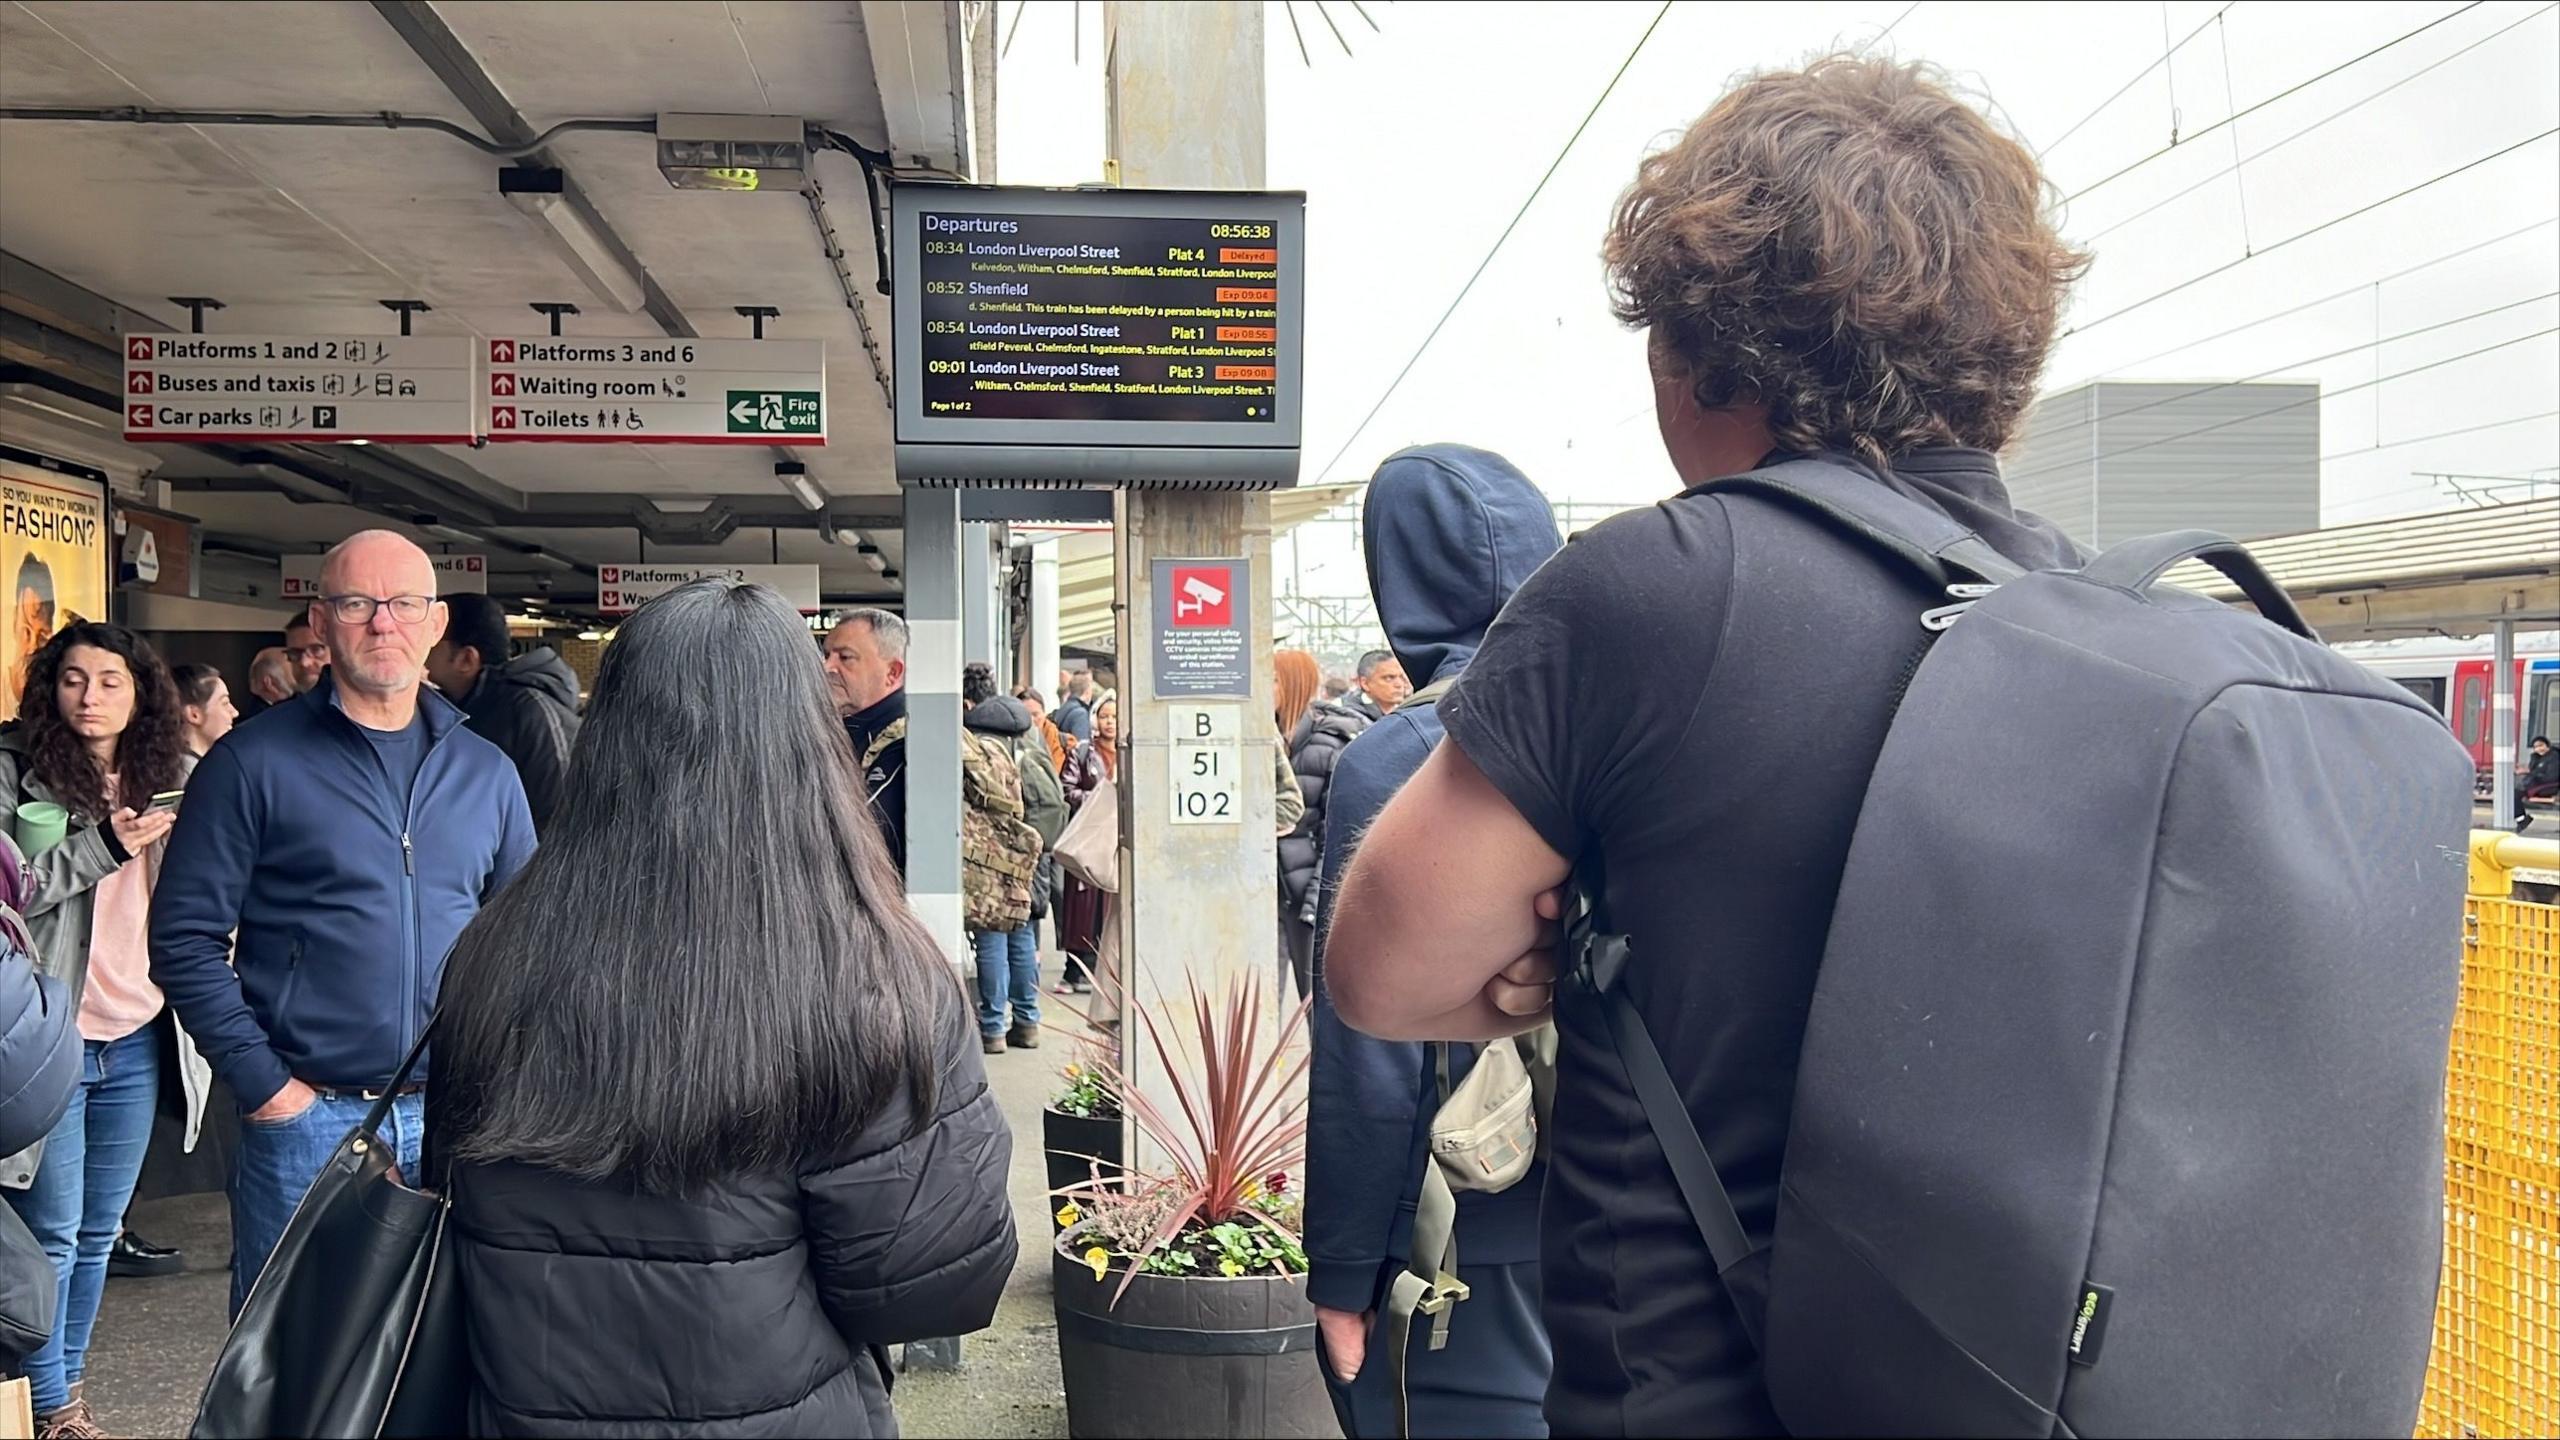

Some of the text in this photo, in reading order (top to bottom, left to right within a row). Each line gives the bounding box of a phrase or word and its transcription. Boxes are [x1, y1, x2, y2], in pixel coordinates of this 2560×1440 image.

[926, 215, 1018, 234] Departures
[1211, 224, 1271, 238] 08:56:38
[926, 242, 1265, 262] 08:34 London Liverpool Street Plat 4 Delayed
[1056, 264, 1110, 276] Chelmsford,
[1111, 265, 1156, 277] Shenfield,
[1157, 267, 1200, 278] Stratford,
[1202, 268, 1235, 278] London
[1236, 268, 1276, 280] Liverpool
[926, 281, 1268, 300] 08:52 Shenfield Exp 09:04
[1025, 303, 1045, 313] This
[1046, 304, 1067, 313] train
[1068, 304, 1084, 314] has
[1085, 305, 1107, 314] been
[1109, 305, 1144, 317] delayed
[1144, 306, 1156, 317] by
[1164, 308, 1195, 317] person
[1196, 307, 1220, 319] being
[1221, 307, 1234, 317] hit
[1235, 308, 1247, 319] by
[1256, 309, 1276, 318] train
[927, 321, 965, 334] 08:54
[969, 322, 1016, 335] London
[1019, 323, 1078, 338] Liverpool
[1080, 324, 1120, 337] Street
[1171, 326, 1195, 339] Plat
[1198, 327, 1205, 339] 1
[1223, 330, 1240, 339] Exp
[158, 341, 337, 359] Platforms 1 and 2
[520, 344, 694, 362] Platforms 3 and 6
[1090, 344, 1145, 355] Ingatestone,
[1191, 346, 1224, 356] London
[1225, 347, 1266, 358] Liverpool
[929, 361, 966, 373] 09:01
[969, 361, 1017, 374] London
[1019, 362, 1078, 377] Liverpool
[1080, 363, 1120, 377] Street
[1169, 365, 1193, 378] Plat
[1195, 366, 1204, 378] 3
[1222, 368, 1238, 378] Exp
[159, 375, 315, 393] Buses and taxis
[520, 377, 656, 399] Waiting room
[975, 380, 1012, 391] Witham,
[1159, 384, 1192, 394] London
[1193, 385, 1233, 396] Liverpool
[788, 398, 817, 411] Fire
[931, 401, 971, 411] Page 1 of 2
[159, 408, 195, 425] Car
[199, 407, 253, 429] parks
[521, 410, 589, 428] Toilets
[789, 413, 817, 426] exit
[3, 486, 95, 516] SO YOU WANT TO WORK IN
[3, 504, 95, 548] FASHION?
[456, 559, 463, 571] 6
[622, 570, 689, 583] Platforms
[1196, 712, 1212, 737] B
[1193, 751, 1218, 776] 51
[1178, 791, 1230, 817] 102
